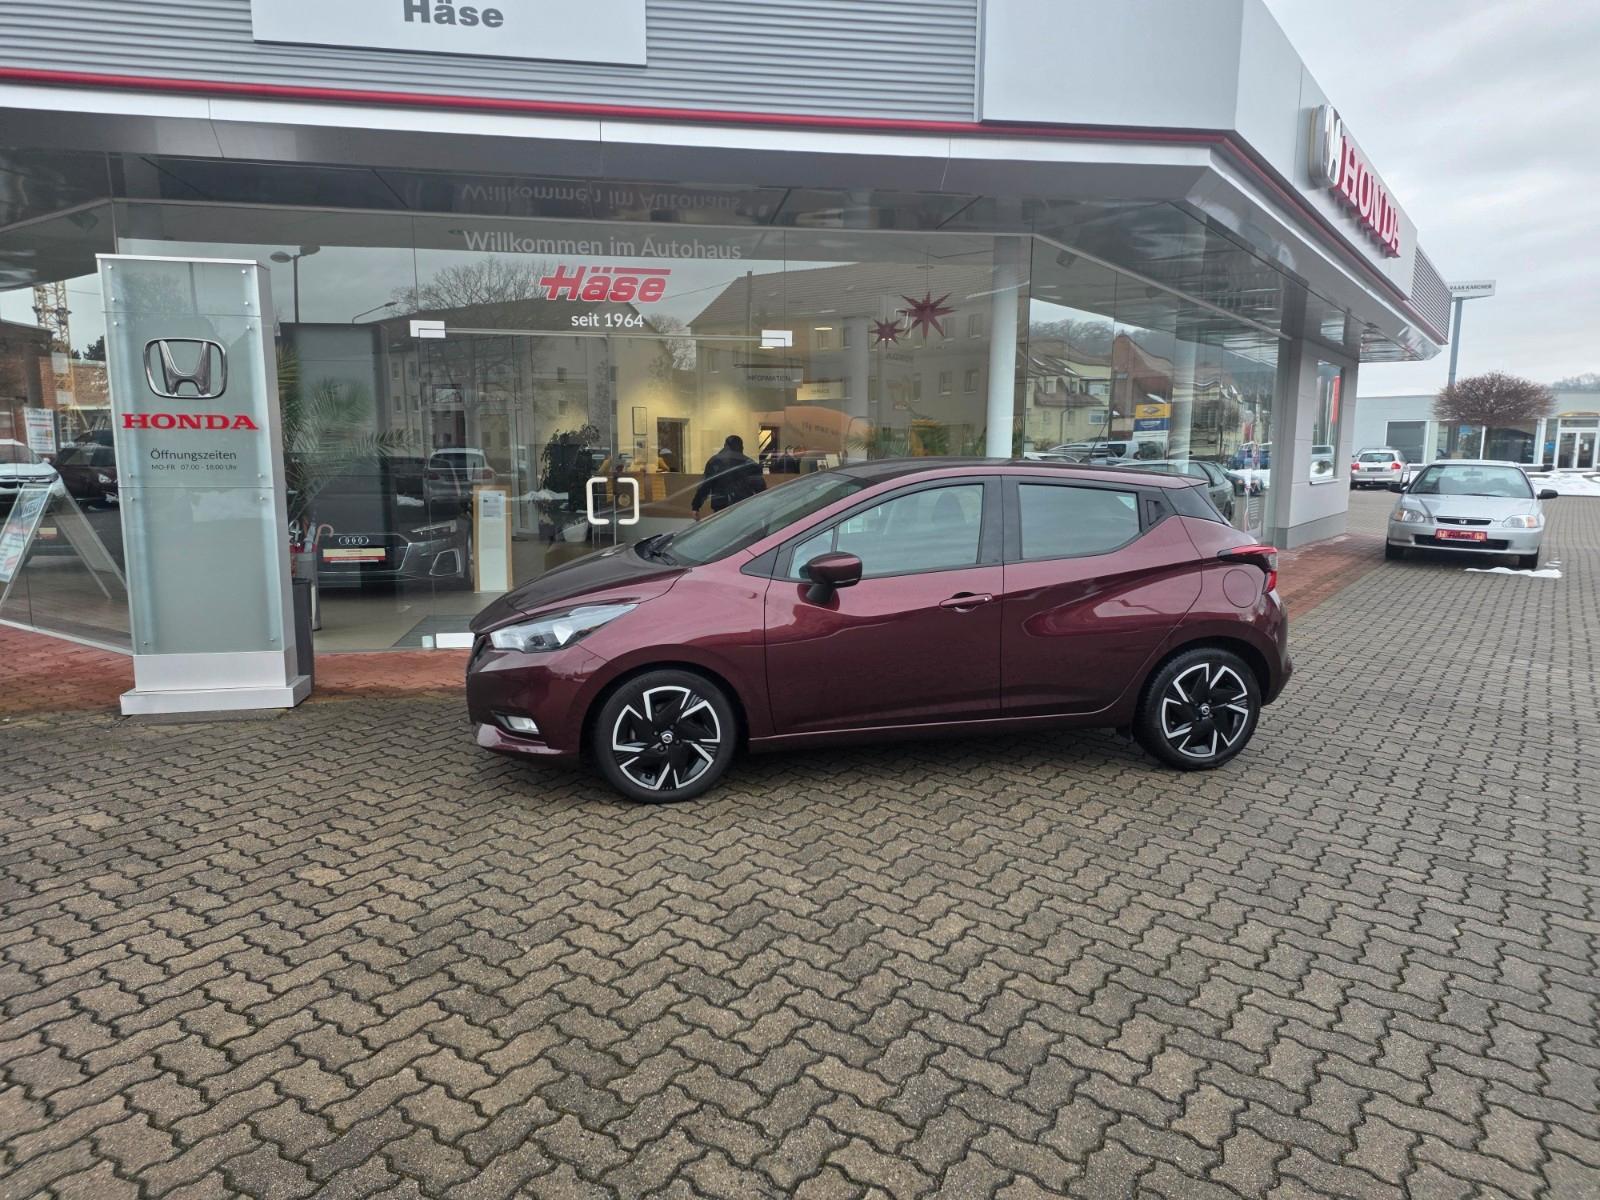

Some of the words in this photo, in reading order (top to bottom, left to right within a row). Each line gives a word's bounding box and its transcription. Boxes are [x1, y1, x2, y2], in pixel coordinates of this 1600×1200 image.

[403, 0, 504, 28] Häse
[1333, 135, 1401, 257] HONDA
[463, 230, 602, 255] Willkommen
[609, 236, 635, 257] im
[641, 236, 742, 260] Autohaus
[539, 264, 672, 303] Häse
[571, 312, 600, 328] seit
[604, 313, 645, 329] 1964
[121, 413, 259, 431] HONDA
[150, 447, 237, 462] Öffnungszeiten
